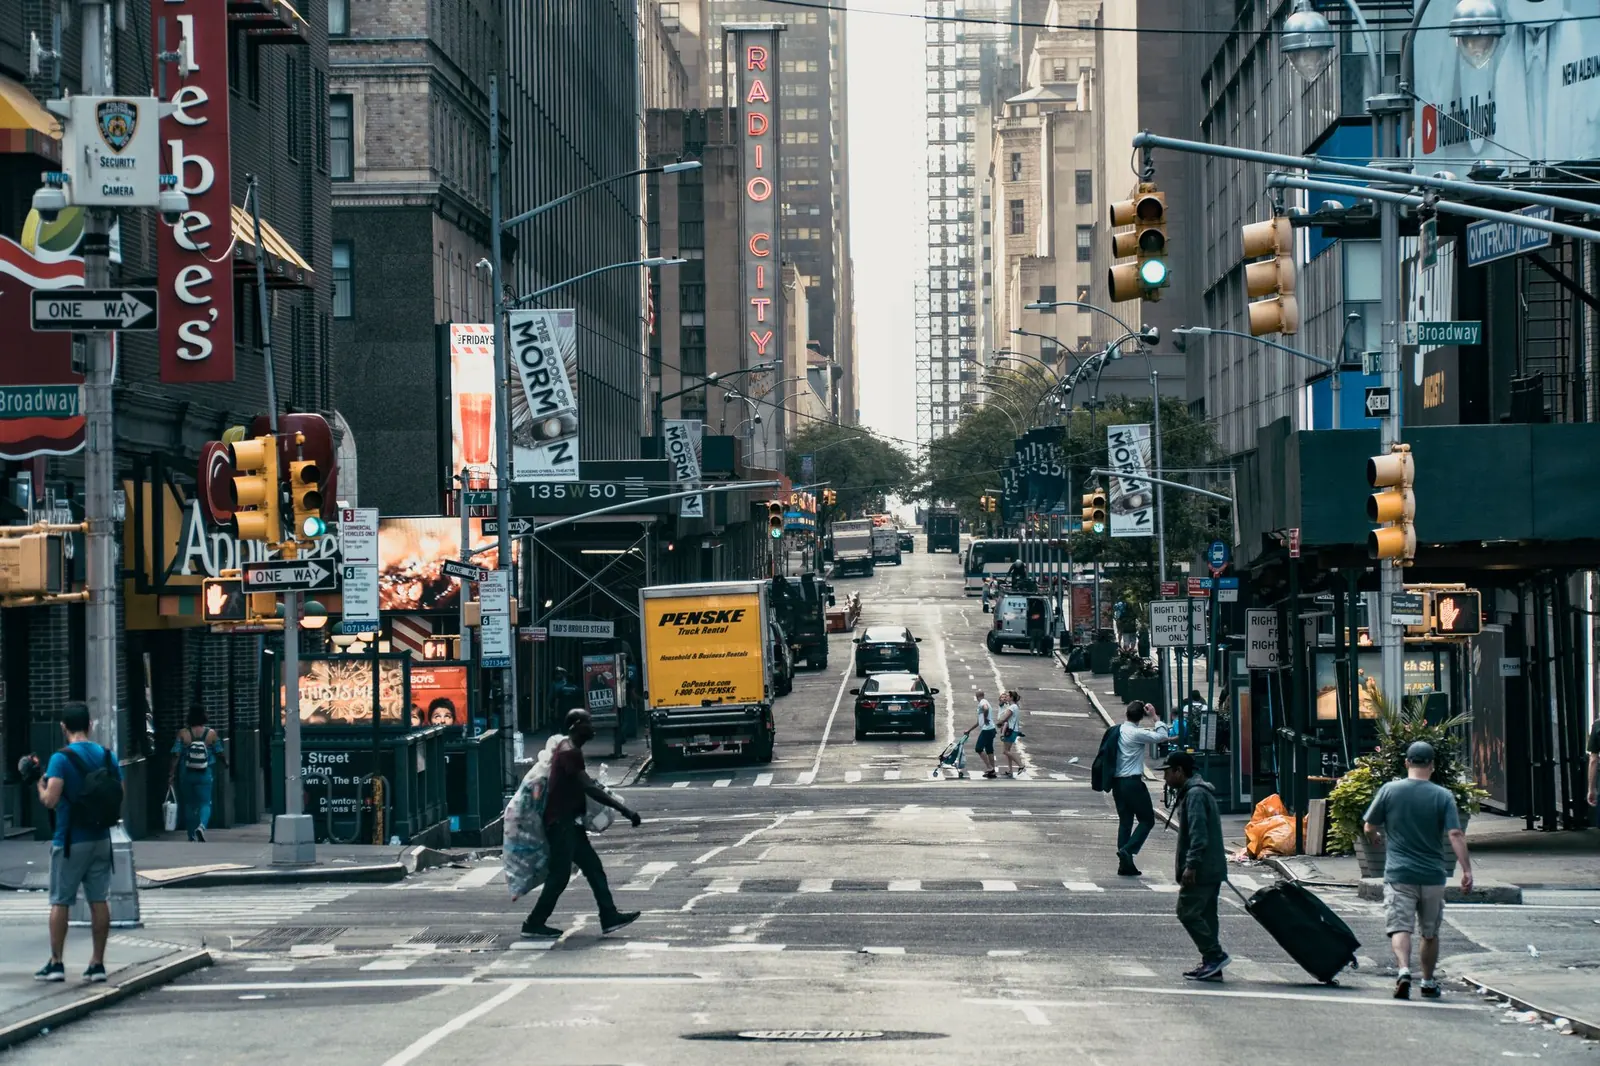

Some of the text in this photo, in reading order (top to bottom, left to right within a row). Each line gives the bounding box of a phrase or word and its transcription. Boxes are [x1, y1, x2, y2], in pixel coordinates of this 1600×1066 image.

[1562, 61, 1578, 87] NEW
[747, 46, 772, 203] RADIO
[1437, 91, 1497, 148] YouTube Music
[749, 233, 773, 355] CITY
[49, 301, 139, 319] ONE WAY
[461, 334, 495, 345] FRIDAYS
[1418, 324, 1479, 344] Broadway
[535, 316, 570, 406] THE BOOK OF
[0, 390, 77, 416] Broadway
[1370, 396, 1388, 409] ONE WAY
[679, 424, 688, 440] THE
[1124, 429, 1135, 447] THE
[683, 441, 694, 464] BOOK
[468, 493, 476, 504] 7
[345, 510, 352, 521] 3
[510, 522, 527, 530] WAY
[255, 569, 321, 583] ONE WAY
[345, 568, 352, 579] 6
[449, 565, 478, 577] ONE WA
[480, 573, 486, 581] 3
[1153, 604, 1202, 614] RIGHT TUNS
[482, 616, 489, 625] 6
[658, 609, 747, 627] PENSKE
[1167, 615, 1189, 623] FROM
[1251, 616, 1278, 626] RIGHT
[552, 624, 567, 632] TAD'S
[567, 624, 590, 633] BROILED
[590, 625, 611, 634] STEAKS
[677, 625, 729, 636] Truck Rental
[1155, 624, 1178, 633] RIGHT
[1168, 634, 1189, 642] ONLY
[1251, 640, 1279, 650] RIGHT
[660, 650, 748, 661] Household & Business Rentals
[410, 674, 435, 684] BOYS
[681, 680, 731, 689] GoPenske.com
[298, 684, 334, 701] THIS
[333, 684, 352, 701] IS
[589, 689, 613, 701] LIFE
[674, 686, 737, 697] 1-800-GO-PENSKE
[308, 752, 350, 764] Street
[301, 764, 333, 776] ation
[333, 776, 350, 785] The
